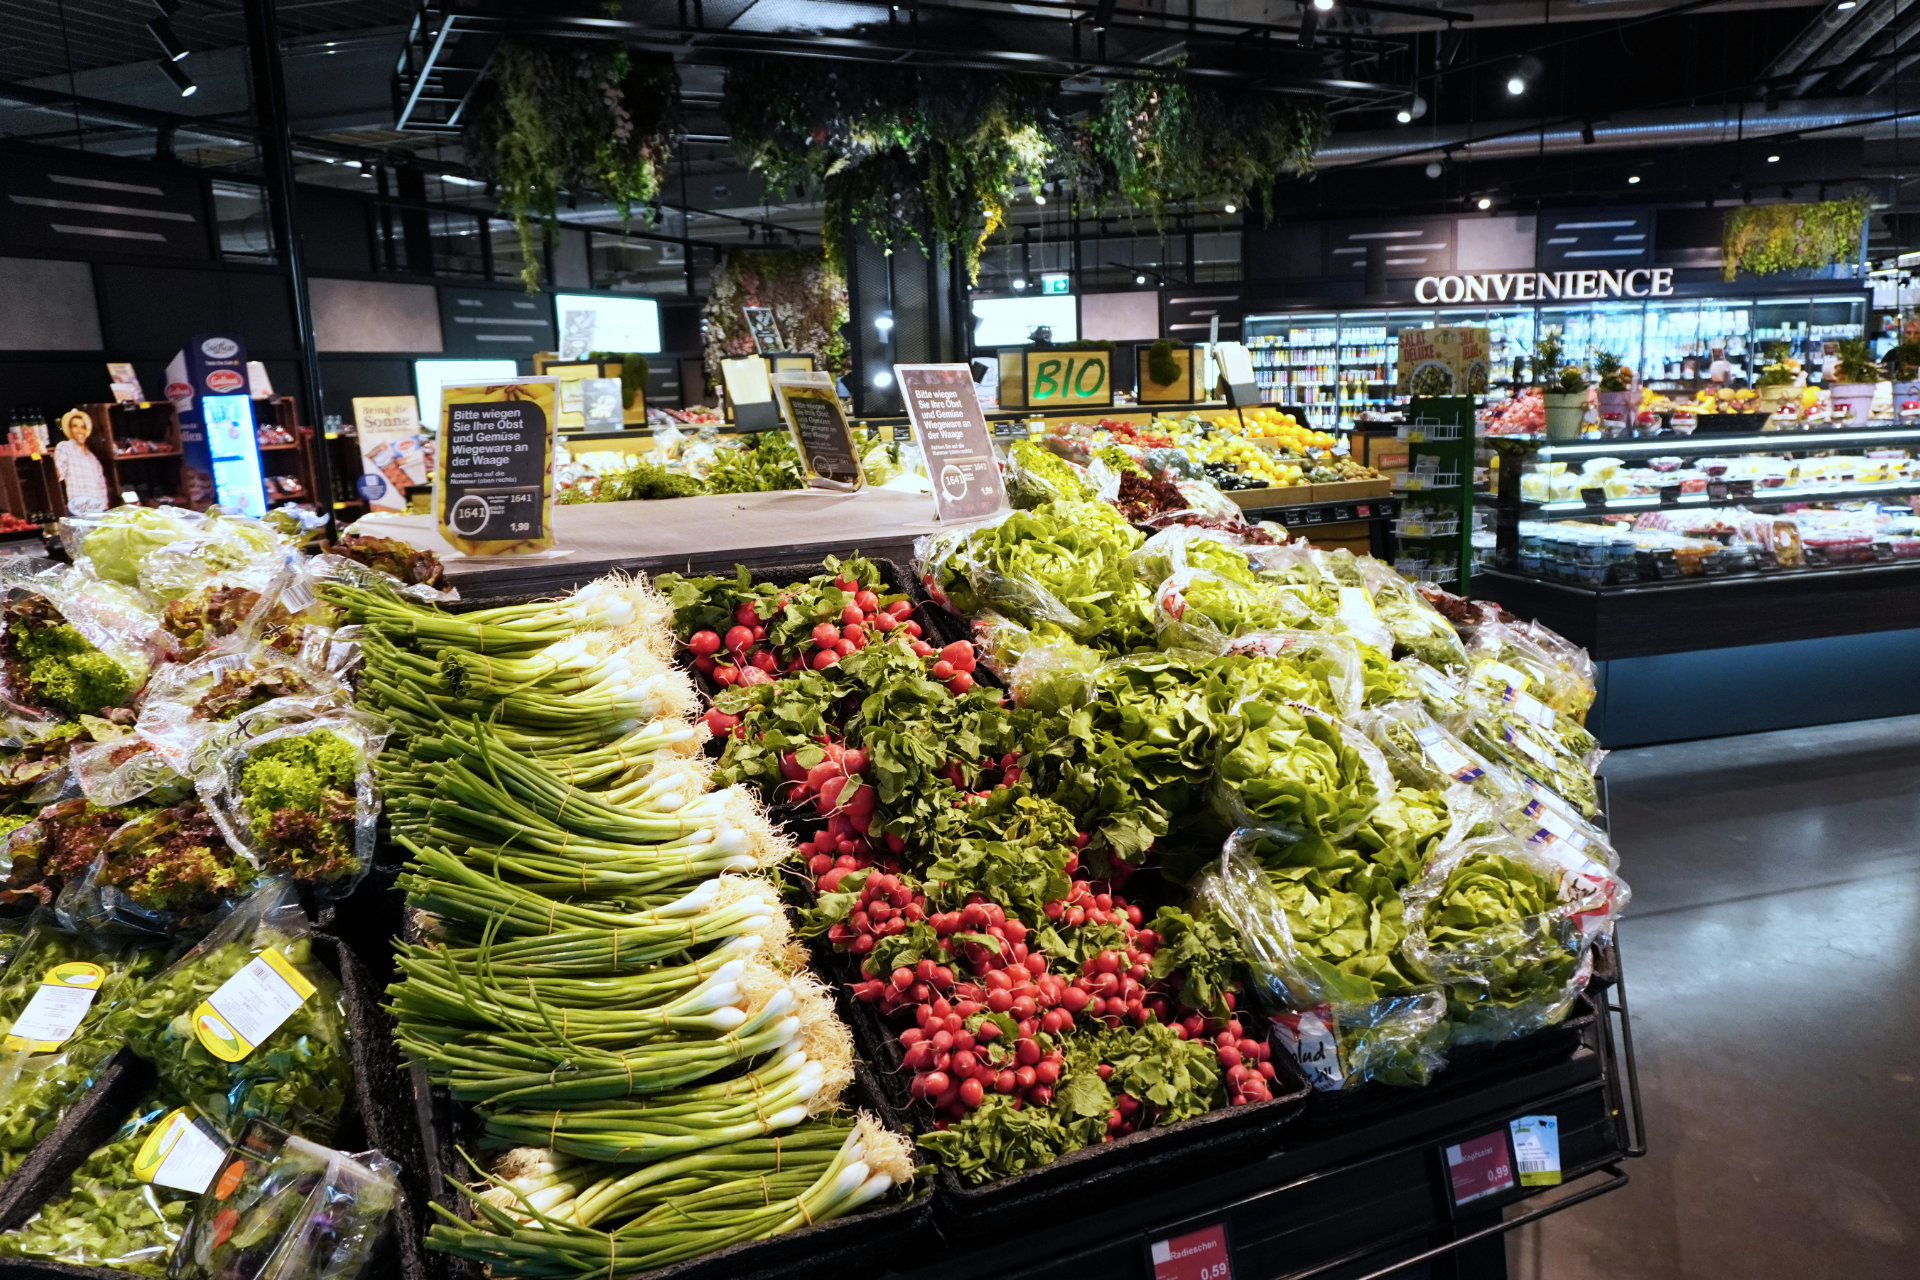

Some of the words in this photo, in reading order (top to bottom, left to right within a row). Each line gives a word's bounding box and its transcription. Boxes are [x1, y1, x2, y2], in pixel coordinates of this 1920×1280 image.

[1414, 268, 1675, 304] CONVENIENCE
[1399, 331, 1427, 350] SALAT
[1403, 344, 1435, 363] DELUXE
[1032, 358, 1106, 400] BIO
[915, 389, 933, 399] Bitte
[933, 390, 958, 401] wiegen
[918, 400, 930, 409] Sie
[931, 400, 945, 408] Ihre
[945, 399, 963, 408] Obst
[453, 410, 480, 420] Bitte
[482, 409, 521, 420] wiegen
[922, 410, 935, 419] und
[936, 409, 964, 419] Gemüse
[364, 416, 411, 428] Sonne
[453, 421, 471, 432] Sie
[473, 421, 495, 431] Ihre
[496, 419, 524, 430] Obst
[923, 420, 962, 431] Wiegeware
[963, 420, 971, 428] an
[452, 433, 473, 443] und
[475, 431, 521, 442] Gemüse
[927, 431, 940, 440] der
[940, 429, 964, 440] Waage
[452, 444, 512, 456] Wiegeware
[514, 444, 529, 452] an
[451, 457, 471, 467] der
[472, 455, 510, 467] Waage
[945, 475, 964, 486] 1641
[510, 494, 532, 503] 1641
[458, 507, 486, 519] 1641
[509, 522, 530, 533] 1,99
[1463, 1146, 1494, 1162] Kopfsalat
[1487, 1165, 1509, 1183] 0,99
[1169, 1240, 1217, 1260] Radieschen
[1201, 1262, 1227, 1280] 0,59
